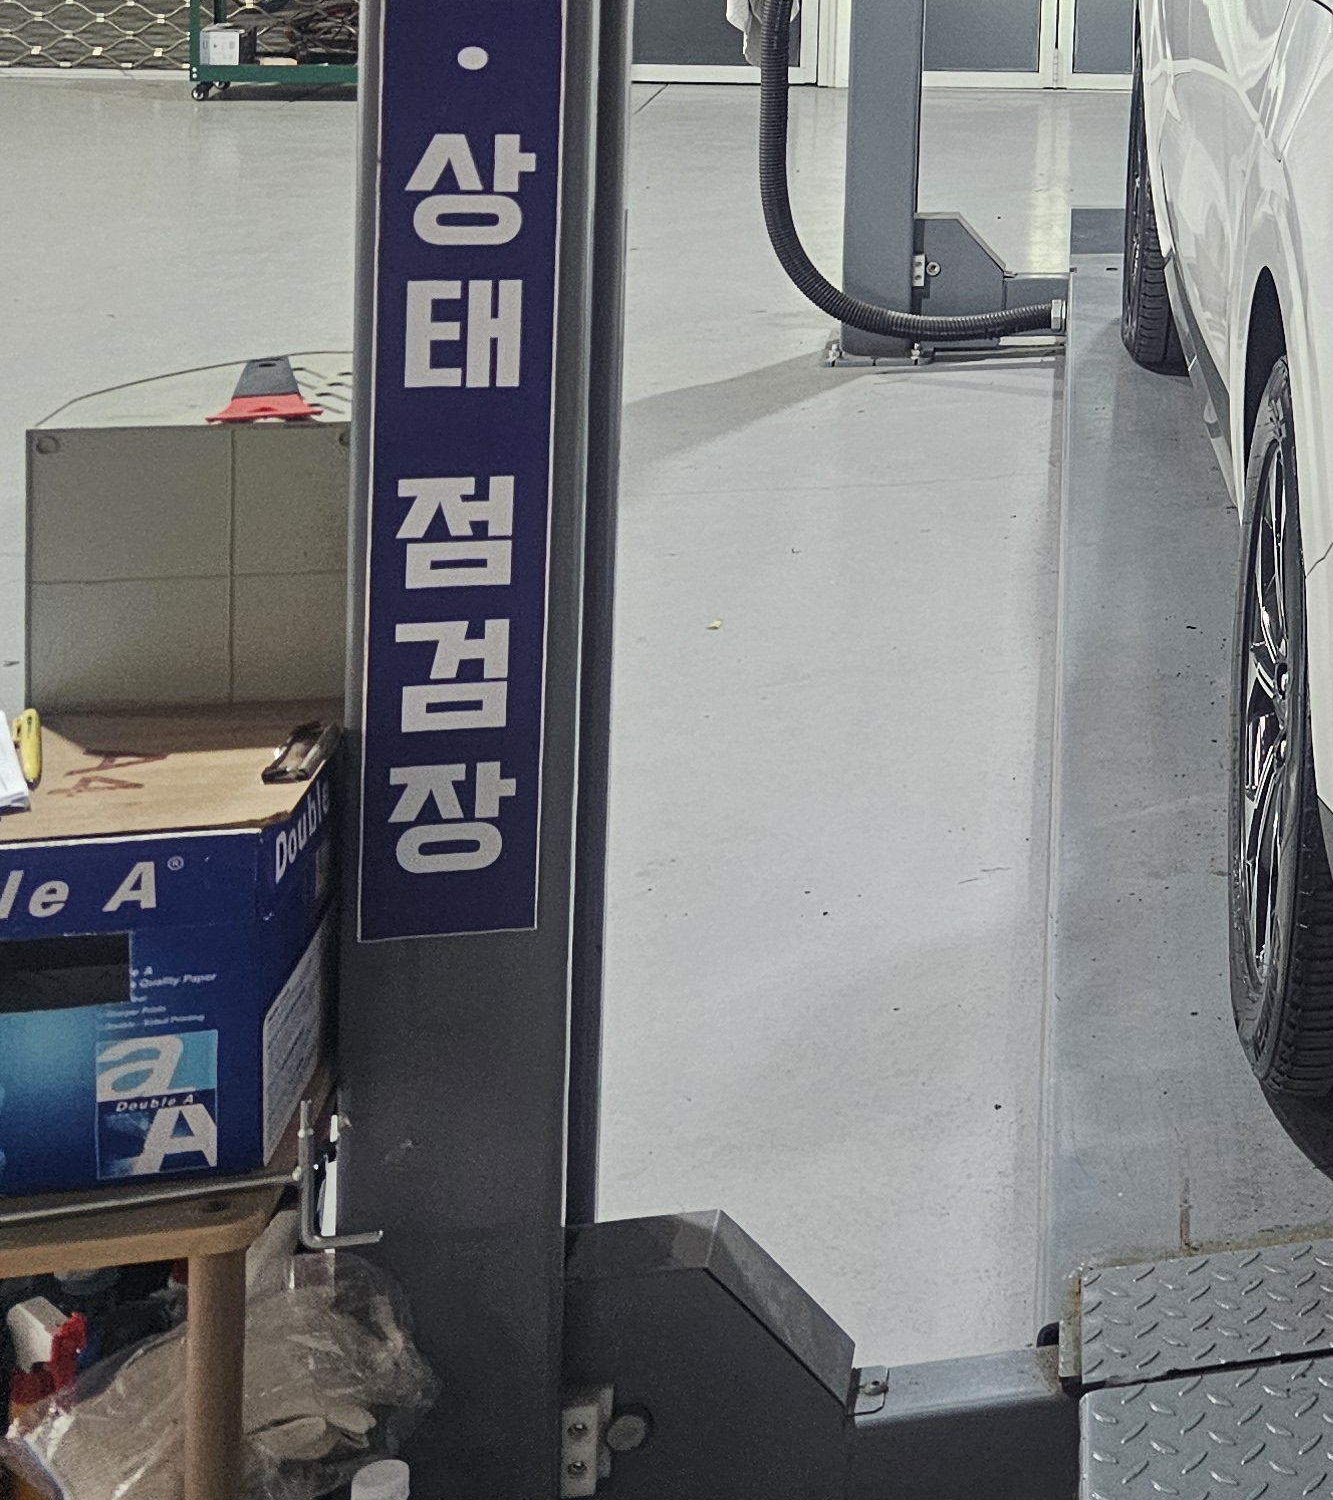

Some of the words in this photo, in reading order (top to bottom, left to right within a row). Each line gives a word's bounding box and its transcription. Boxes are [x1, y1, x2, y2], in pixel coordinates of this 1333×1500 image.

[388, 475, 516, 874] 점검장
[275, 779, 330, 885] Double
[116, 1097, 177, 1113] Double
[183, 1094, 194, 1105] A
